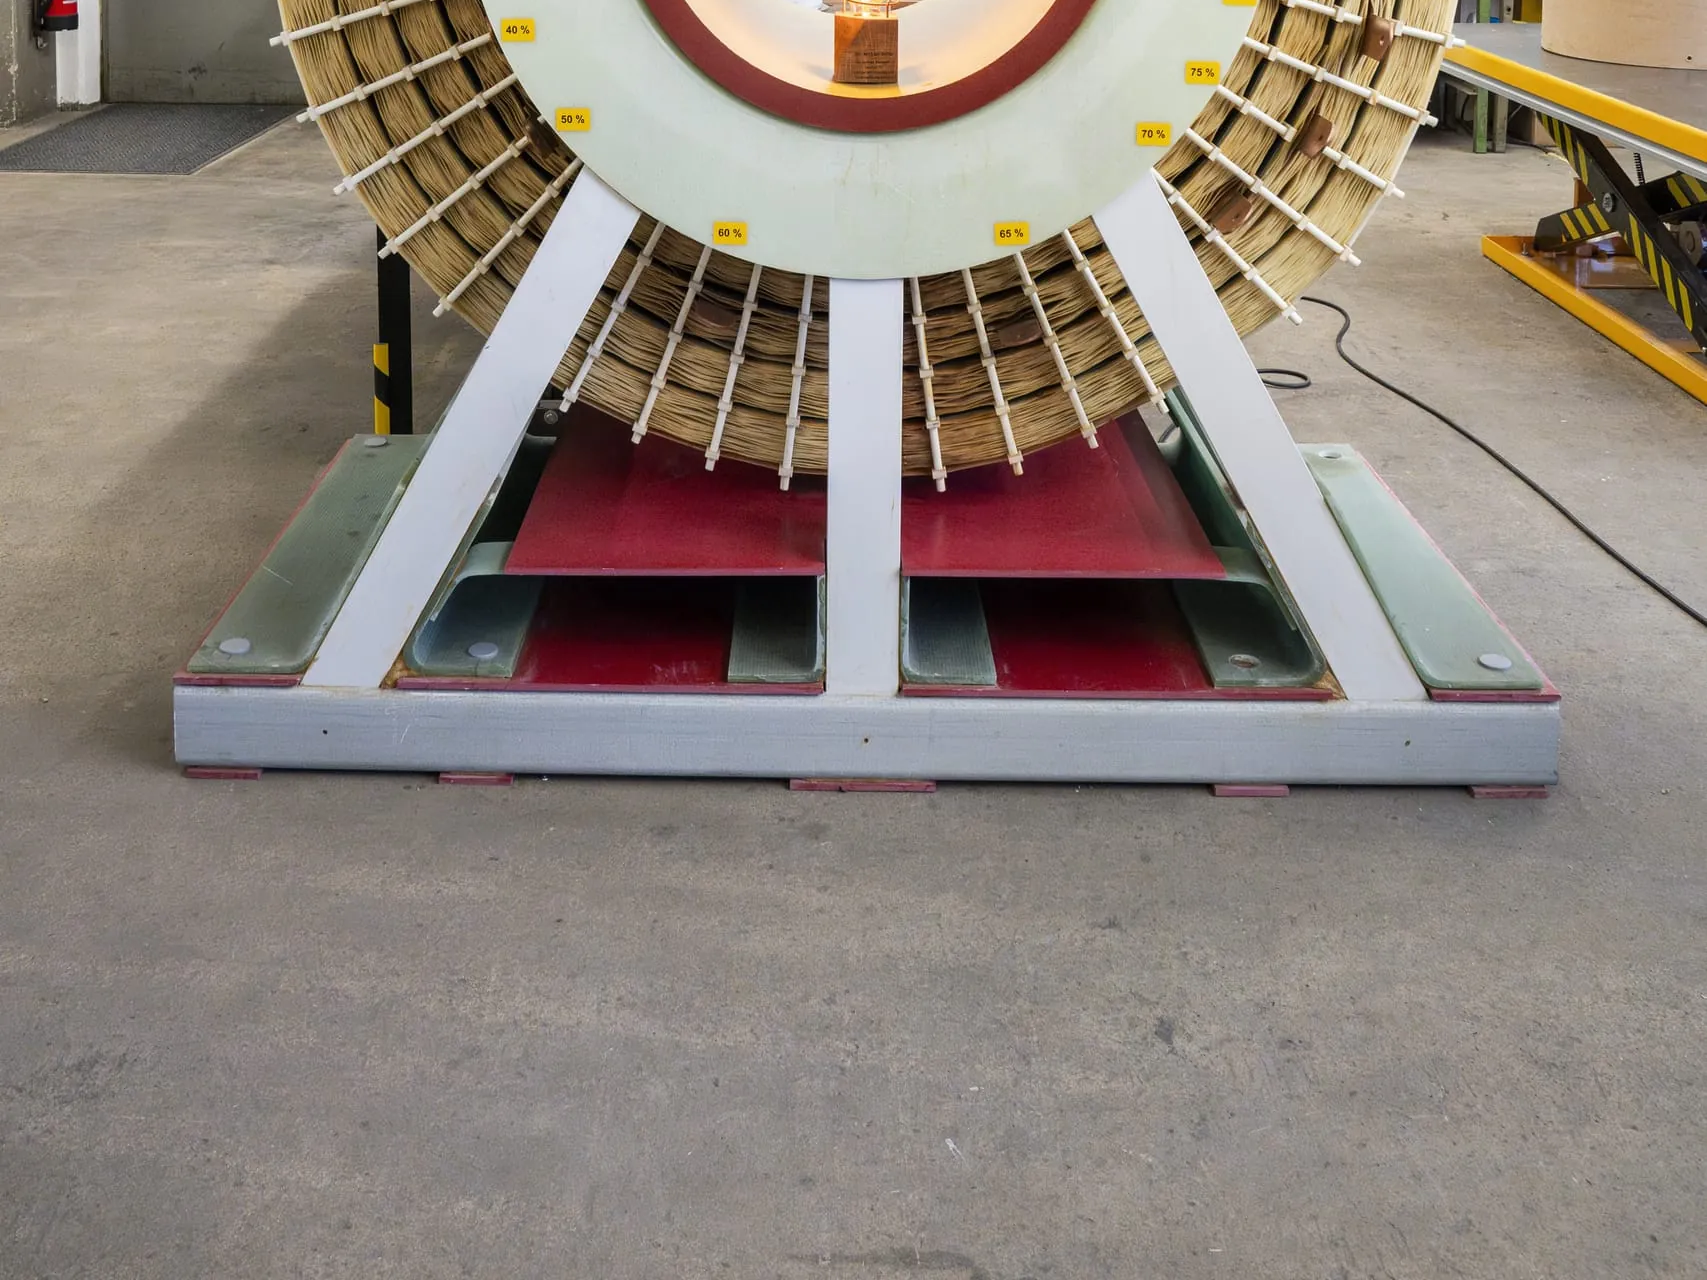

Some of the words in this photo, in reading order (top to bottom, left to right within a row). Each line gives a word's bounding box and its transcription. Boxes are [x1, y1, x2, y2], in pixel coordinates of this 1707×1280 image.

[506, 26, 517, 34] 40
[521, 25, 530, 34] %
[1191, 68, 1202, 76] 75
[1206, 68, 1214, 77] %
[561, 115, 572, 123] 50
[576, 115, 584, 124] %
[1141, 130, 1153, 138] 70
[1156, 130, 1165, 139] %
[718, 229, 730, 237] 60
[733, 229, 742, 238] %
[1000, 229, 1011, 238] 65
[1014, 228, 1024, 237] %
